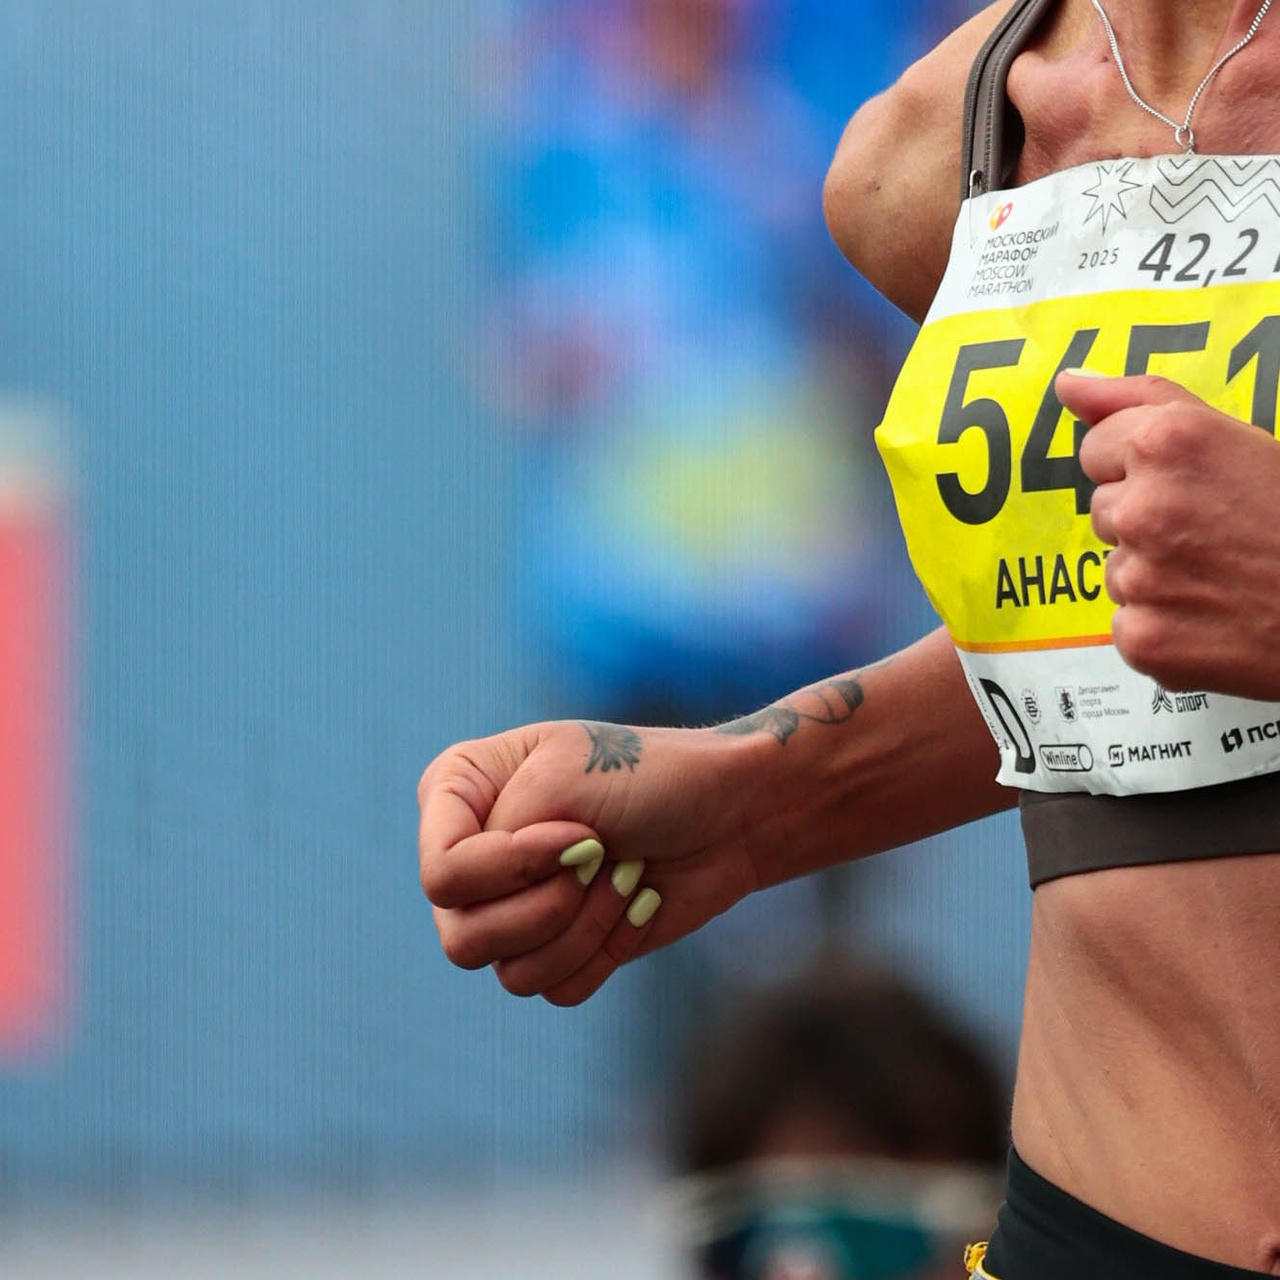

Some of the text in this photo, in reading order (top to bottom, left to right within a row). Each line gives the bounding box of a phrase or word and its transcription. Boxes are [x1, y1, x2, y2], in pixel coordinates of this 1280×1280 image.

[984, 222, 1060, 251] МОСКОВСКИЙ
[979, 246, 1040, 266] МАРАФОН
[1077, 248, 1120, 270] 2025
[1137, 228, 1260, 288] 42,2
[972, 265, 1030, 282] MOSCOW
[967, 277, 1035, 300] MARATHON
[996, 549, 1112, 609] АНАС
[1175, 692, 1210, 714] СПОРТ
[1044, 750, 1078, 766] Winline
[1128, 741, 1193, 763] МАГНИТ
